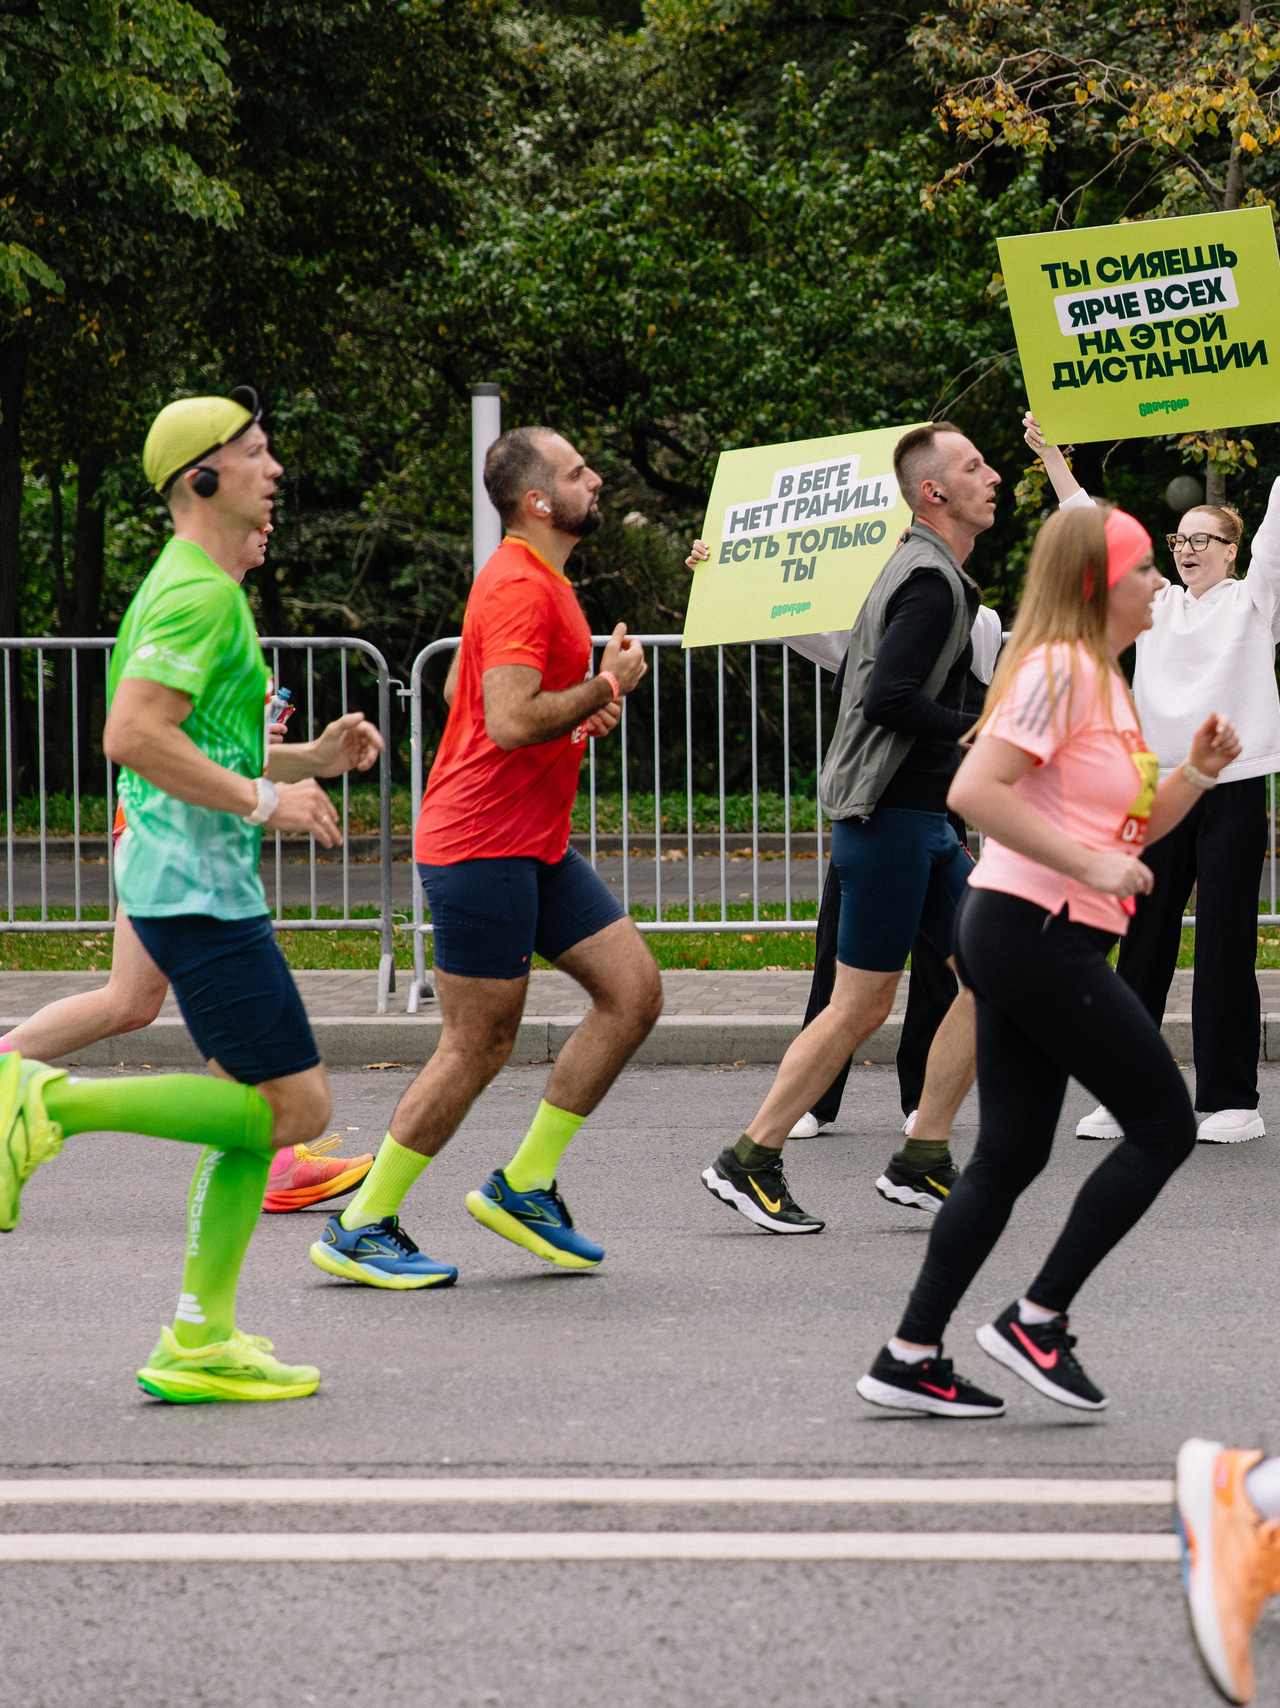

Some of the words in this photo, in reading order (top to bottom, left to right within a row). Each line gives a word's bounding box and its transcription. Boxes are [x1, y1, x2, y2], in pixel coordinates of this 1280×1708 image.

[1041, 259, 1091, 289] ТЫ
[1096, 243, 1238, 283] СИЯЕШЬ
[1067, 291, 1141, 328] ЯРЧЕ
[1144, 276, 1227, 314] ВСЕХ
[1077, 326, 1125, 356] НА
[1129, 312, 1227, 350] ЭТОЙ
[1051, 339, 1268, 391] ДИСТАНЦИИ
[778, 475, 794, 499] В
[797, 462, 852, 494] БЕГЕ
[729, 503, 779, 534] НЕТ
[780, 482, 889, 524] ГРАНИЦ,
[718, 534, 780, 565] ЕСТЬ
[786, 520, 887, 556] ТОЛЬКО
[780, 556, 817, 583] ТЫ
